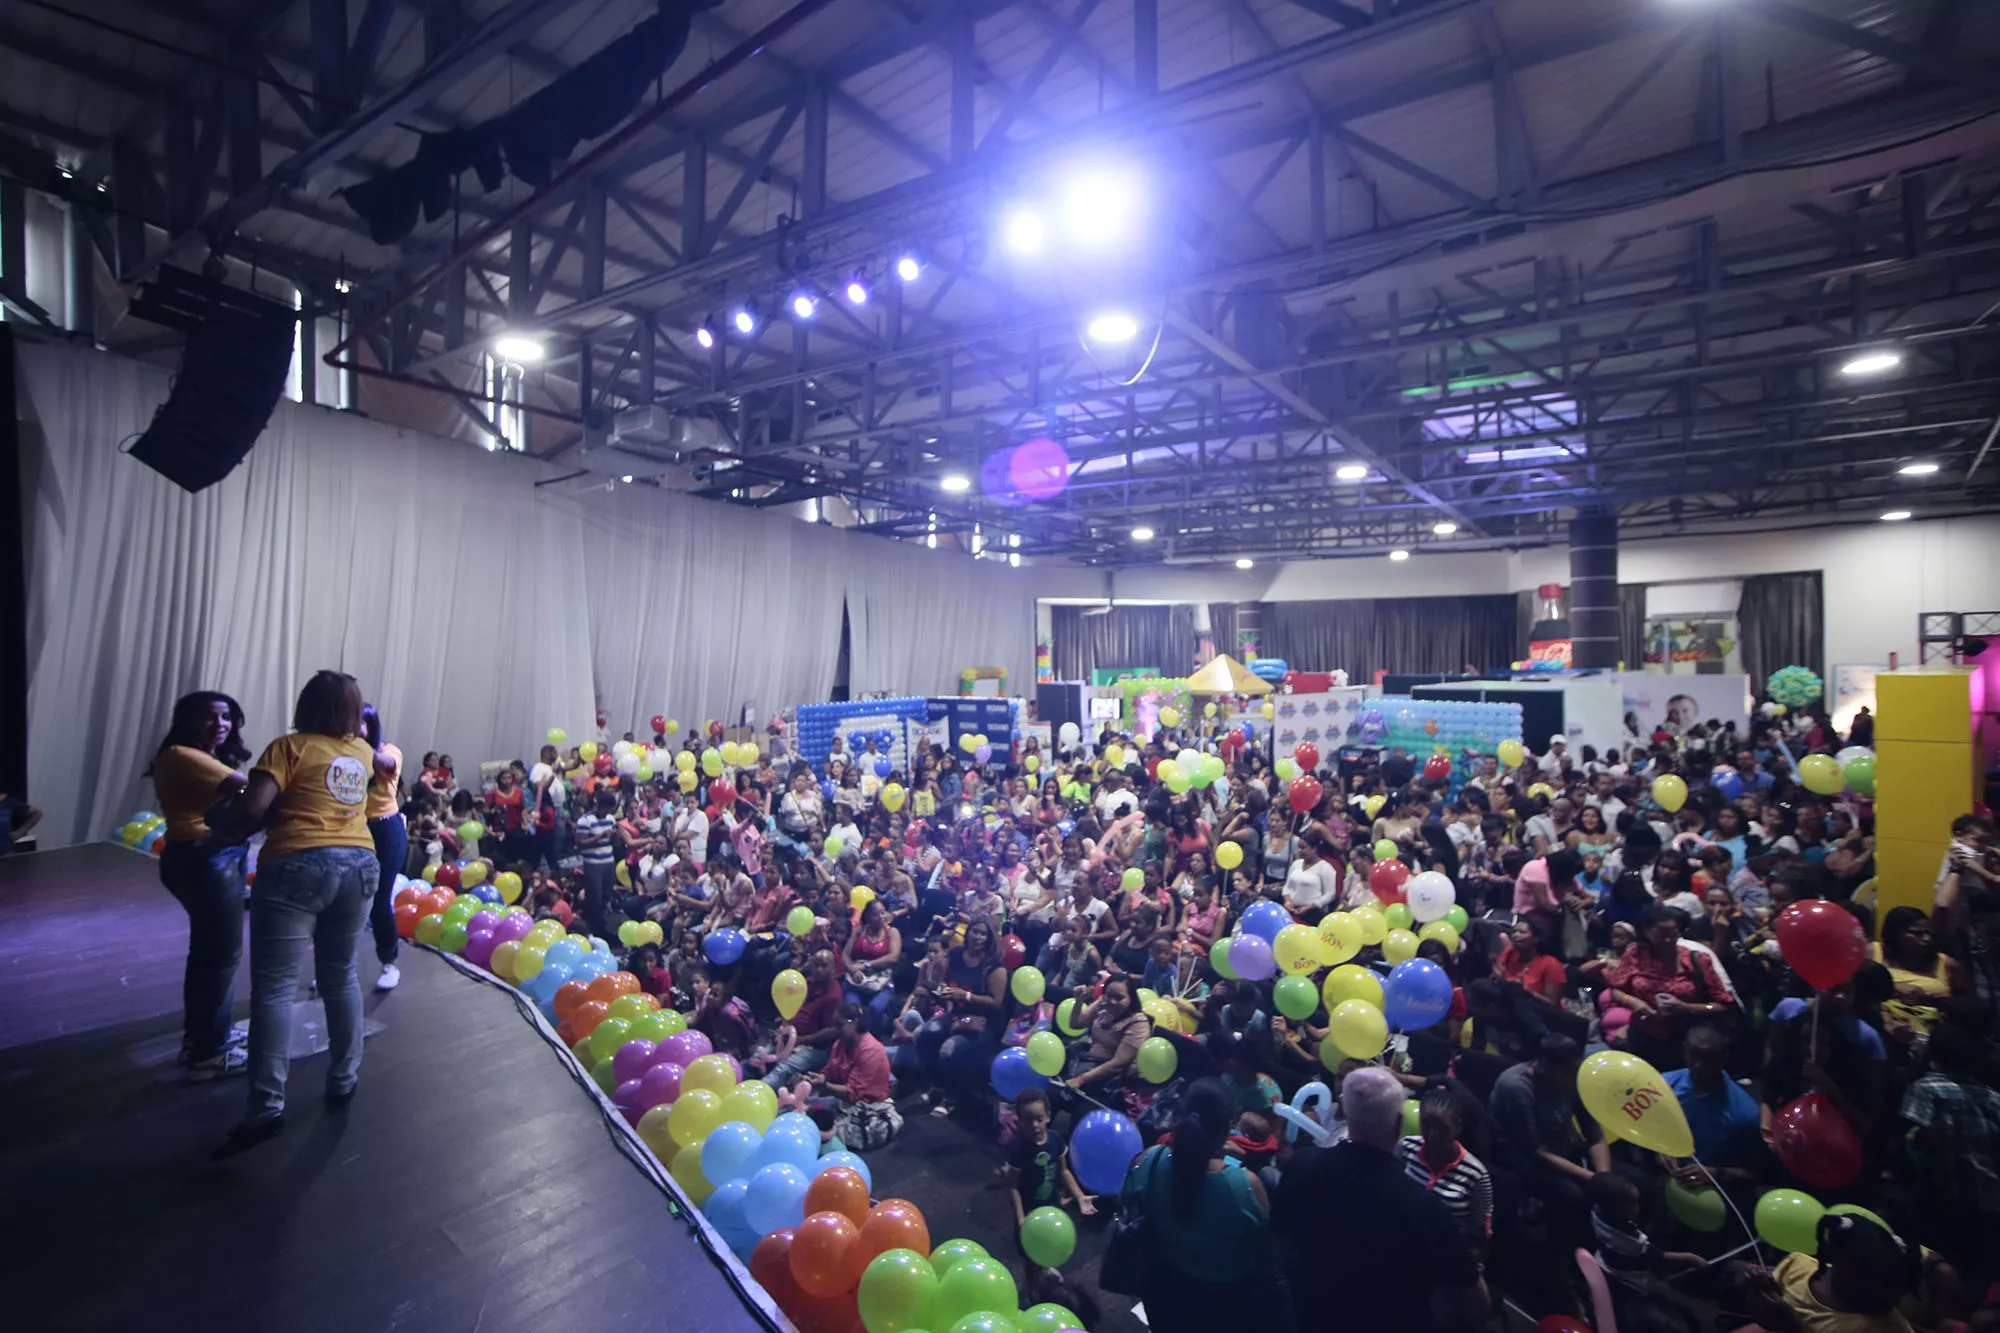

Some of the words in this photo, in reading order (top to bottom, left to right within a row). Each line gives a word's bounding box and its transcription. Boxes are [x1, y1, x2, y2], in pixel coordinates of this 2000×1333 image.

[1320, 931, 1343, 951] BON
[1293, 959, 1318, 970] BON
[1621, 1087, 1663, 1121] BON
